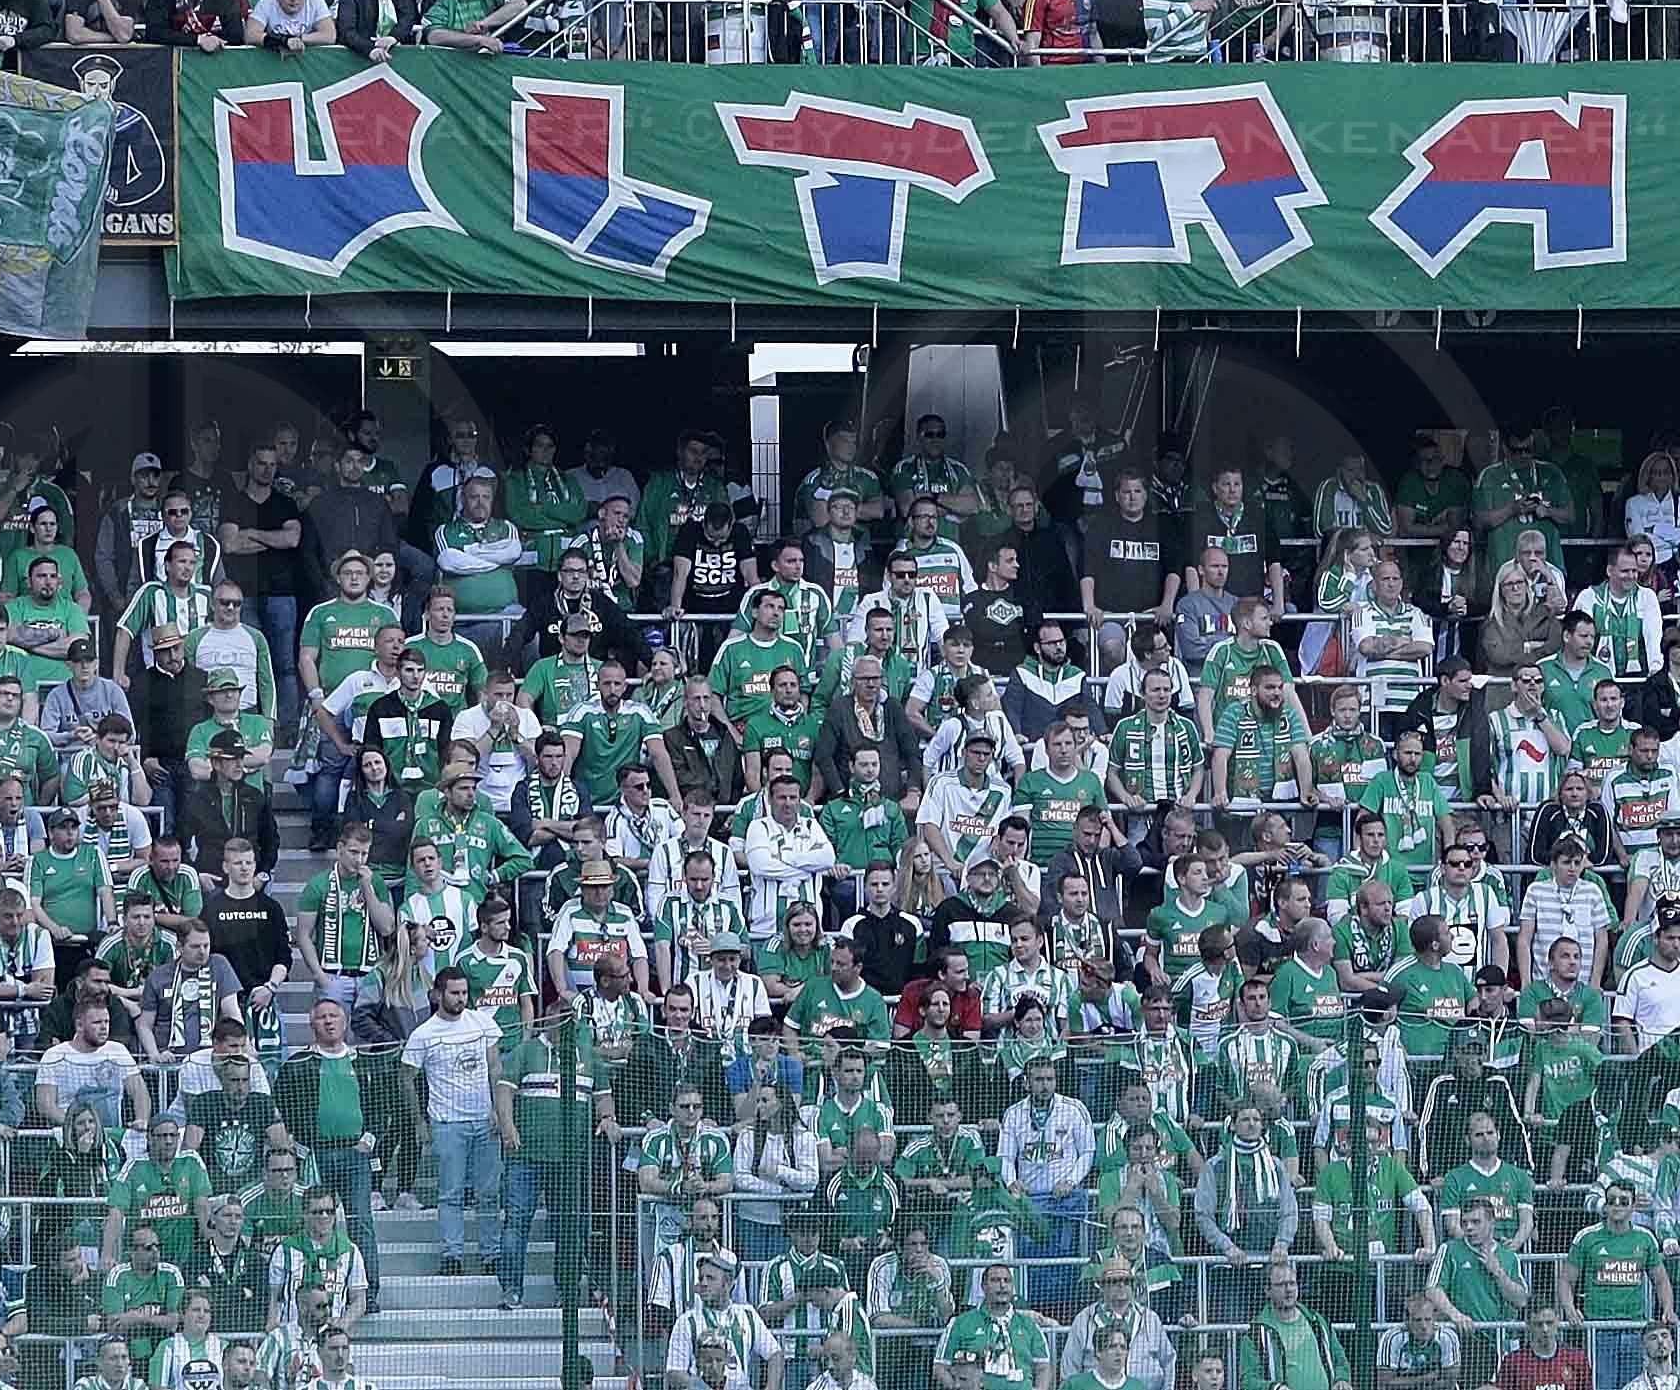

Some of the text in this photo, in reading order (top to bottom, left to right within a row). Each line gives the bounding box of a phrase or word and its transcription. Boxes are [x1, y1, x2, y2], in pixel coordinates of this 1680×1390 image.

[100, 211, 175, 235] GANS
[695, 549, 737, 568] LBS
[693, 568, 739, 584] SCR
[338, 628, 370, 637] WIEN
[331, 637, 375, 648] ENERGIE
[218, 911, 269, 920] OUTCOME
